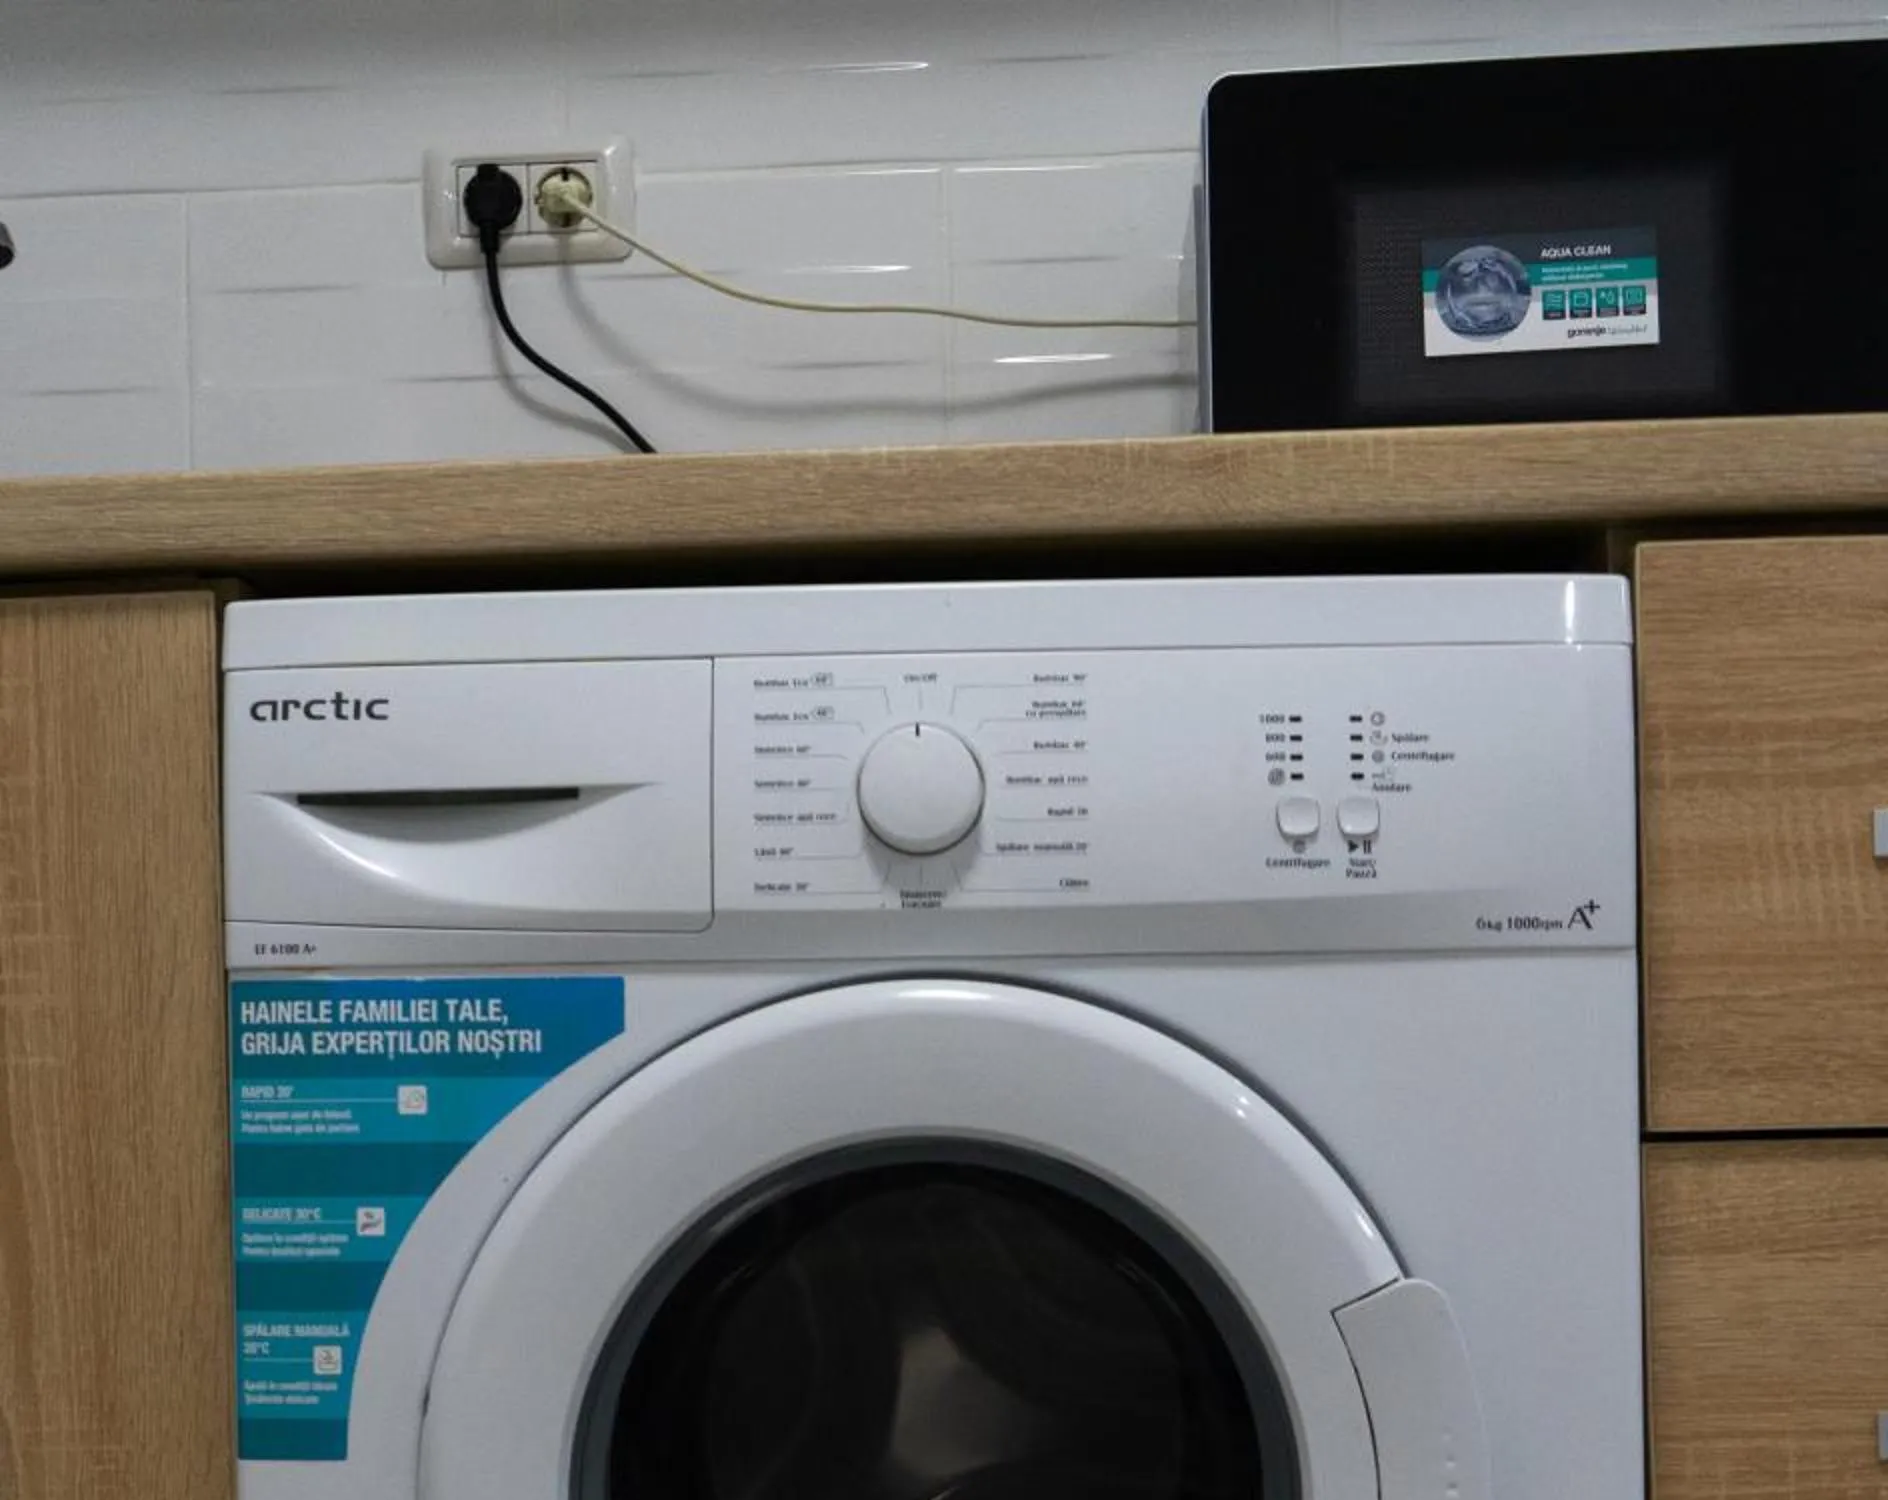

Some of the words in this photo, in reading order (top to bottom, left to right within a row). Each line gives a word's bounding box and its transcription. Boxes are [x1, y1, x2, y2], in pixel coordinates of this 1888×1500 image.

[1541, 247, 1573, 259] AQUA
[1573, 245, 1611, 257] CLEAN
[250, 691, 390, 722] arctic
[1475, 916, 1502, 933] 6kg
[1506, 916, 1564, 931] 1000rpm
[1567, 899, 1601, 931] A+
[255, 943, 267, 957] EF
[270, 943, 299, 957] 6100
[240, 1001, 333, 1025] HAINELE
[339, 999, 438, 1024] FAMILIEI
[446, 998, 509, 1027] TALE,
[241, 1032, 305, 1056] GRIJA
[312, 1030, 451, 1060] EXPERȚILOR
[457, 1029, 542, 1060] NOȘTRI
[241, 1085, 274, 1099] RAPID
